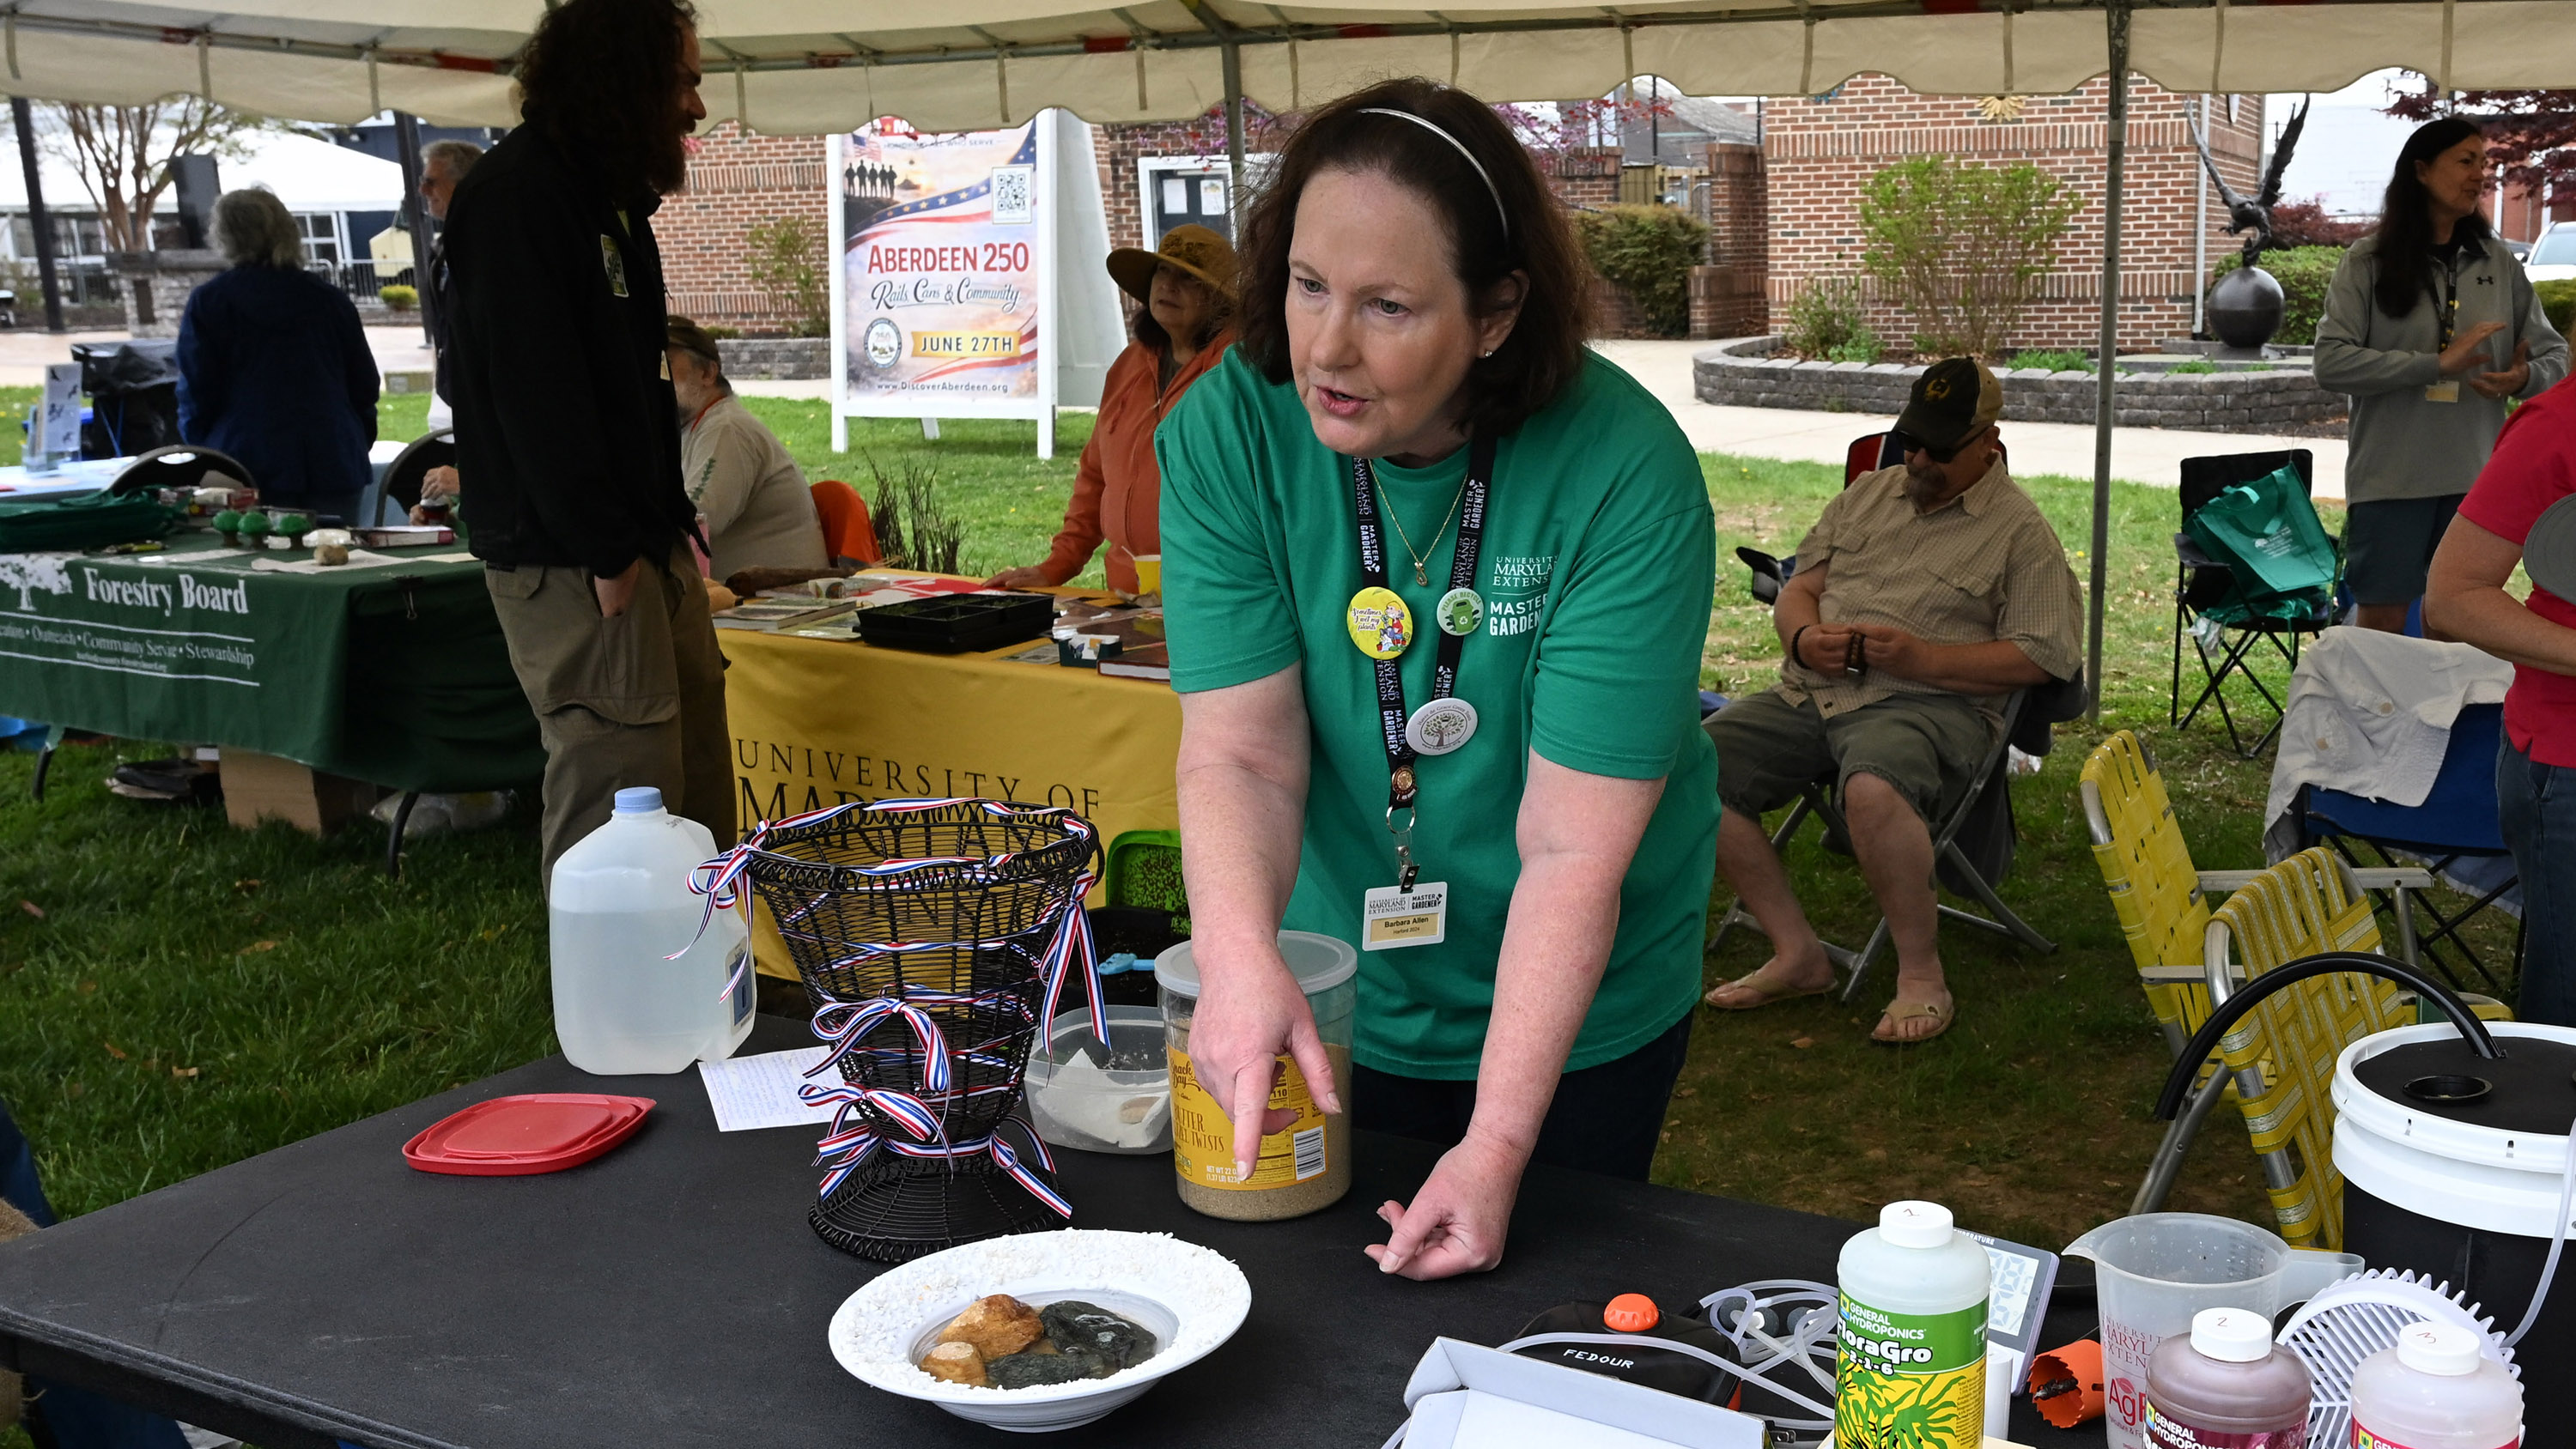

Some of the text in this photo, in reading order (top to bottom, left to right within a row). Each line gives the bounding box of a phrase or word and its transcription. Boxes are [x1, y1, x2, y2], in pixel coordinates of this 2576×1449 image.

[867, 242, 1030, 274] ABERDEEN 250
[914, 278, 940, 302] Cans
[945, 284, 955, 305] &
[957, 277, 1022, 313] Community
[920, 336, 1012, 352] JUNE 27TH
[877, 381, 1008, 393] www.DiscoverAberdeen.org
[1461, 490, 1474, 528] MASTER
[1469, 488, 1485, 529] GARDENER
[1360, 524, 1373, 566] GARDENER
[1368, 524, 1380, 561] MASTER
[1451, 549, 1462, 588] NIVERSITY
[1494, 563, 1554, 577] MARYLA
[82, 567, 249, 617] Forestry Board
[1442, 592, 1458, 611] PLEASE
[1352, 608, 1382, 617] Sometimes
[31, 625, 76, 646] Outreach
[82, 631, 143, 658] Community
[185, 642, 255, 670] Stewardship
[1383, 710, 1398, 749] GARDENER
[1394, 709, 1406, 745] MASTER
[736, 738, 1099, 820] UNIVERSITY OF
[1368, 906, 1406, 915] EXTENSION
[1369, 900, 1406, 910] MARYLAND
[1412, 900, 1437, 910] GARDENER
[1384, 919, 1411, 928] Barbara
[1172, 1074, 1194, 1091] Day
[1190, 1131, 1224, 1153] TWISTS
[1953, 1228, 1995, 1246] ERATURE
[1849, 1313, 1924, 1340] HYDROPONICS
[1850, 1301, 1891, 1326] GENERAL
[2217, 1317, 2228, 1327] 2
[1838, 1314, 1933, 1366] FloraGro
[1563, 1349, 1635, 1370] FEDOUR
[1849, 1349, 1894, 1376] 2-1-6
[2153, 1423, 2231, 1449] HYDROPO
[2154, 1412, 2196, 1442] GENERAL
